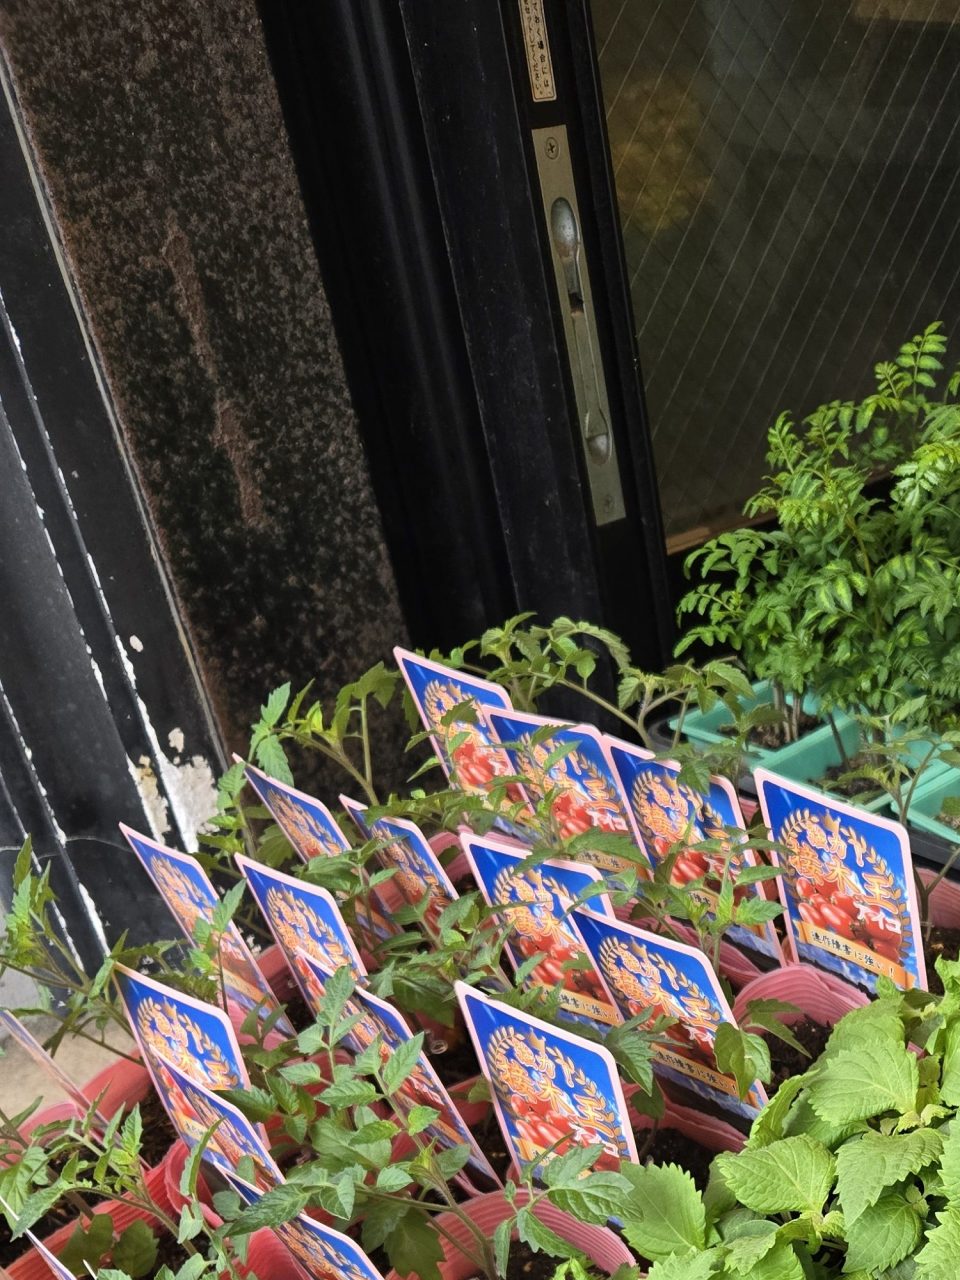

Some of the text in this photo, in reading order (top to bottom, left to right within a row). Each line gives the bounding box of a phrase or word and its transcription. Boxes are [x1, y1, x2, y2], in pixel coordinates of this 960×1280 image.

[853, 900, 902, 933] アイコ
[682, 1024, 715, 1049] アイ
